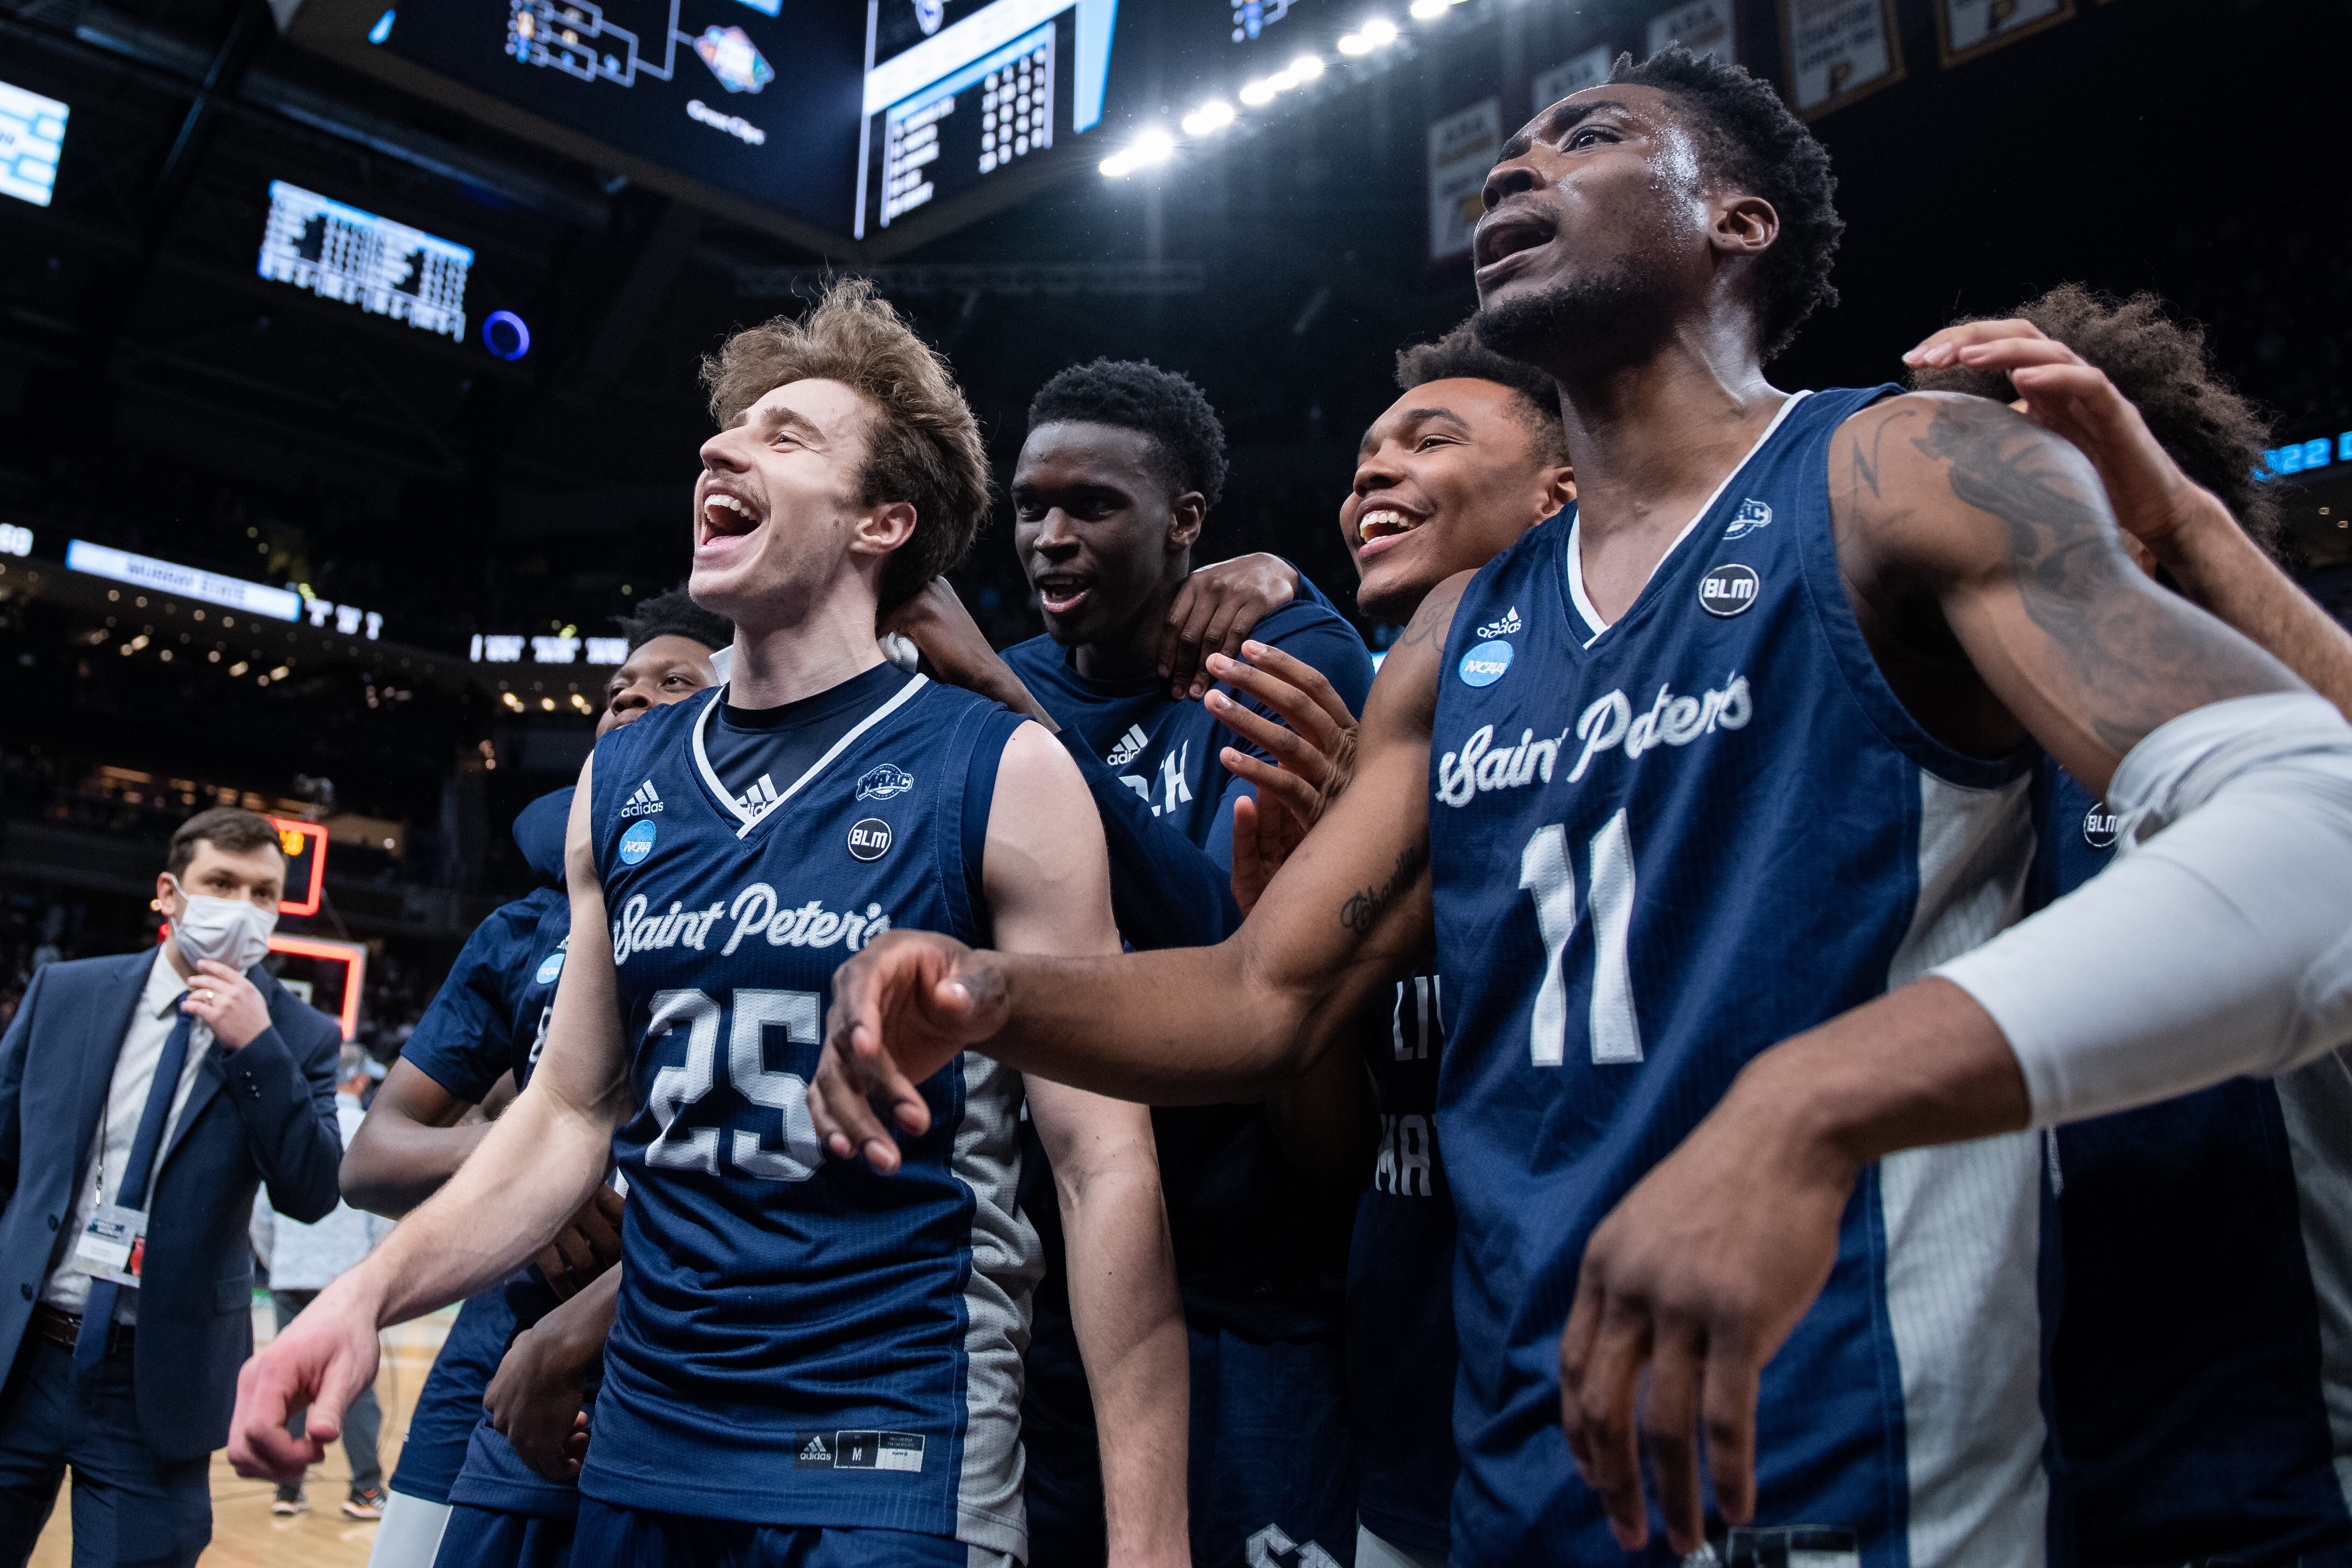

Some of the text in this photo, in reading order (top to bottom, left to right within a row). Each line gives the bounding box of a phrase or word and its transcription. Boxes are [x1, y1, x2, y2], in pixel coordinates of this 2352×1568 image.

[1704, 578, 1754, 599] BLM
[1464, 660, 1508, 674] NCAA
[857, 772, 911, 798] MAAC
[621, 802, 664, 818] adidas
[623, 840, 652, 853] NCAA
[851, 829, 888, 848] BLM
[613, 894, 726, 966] Saint
[1519, 807, 1644, 1067] 11
[645, 988, 826, 1182] 25
[1375, 1114, 1437, 1197] MA
[800, 1452, 831, 1461] adidas
[852, 1447, 862, 1461] M
